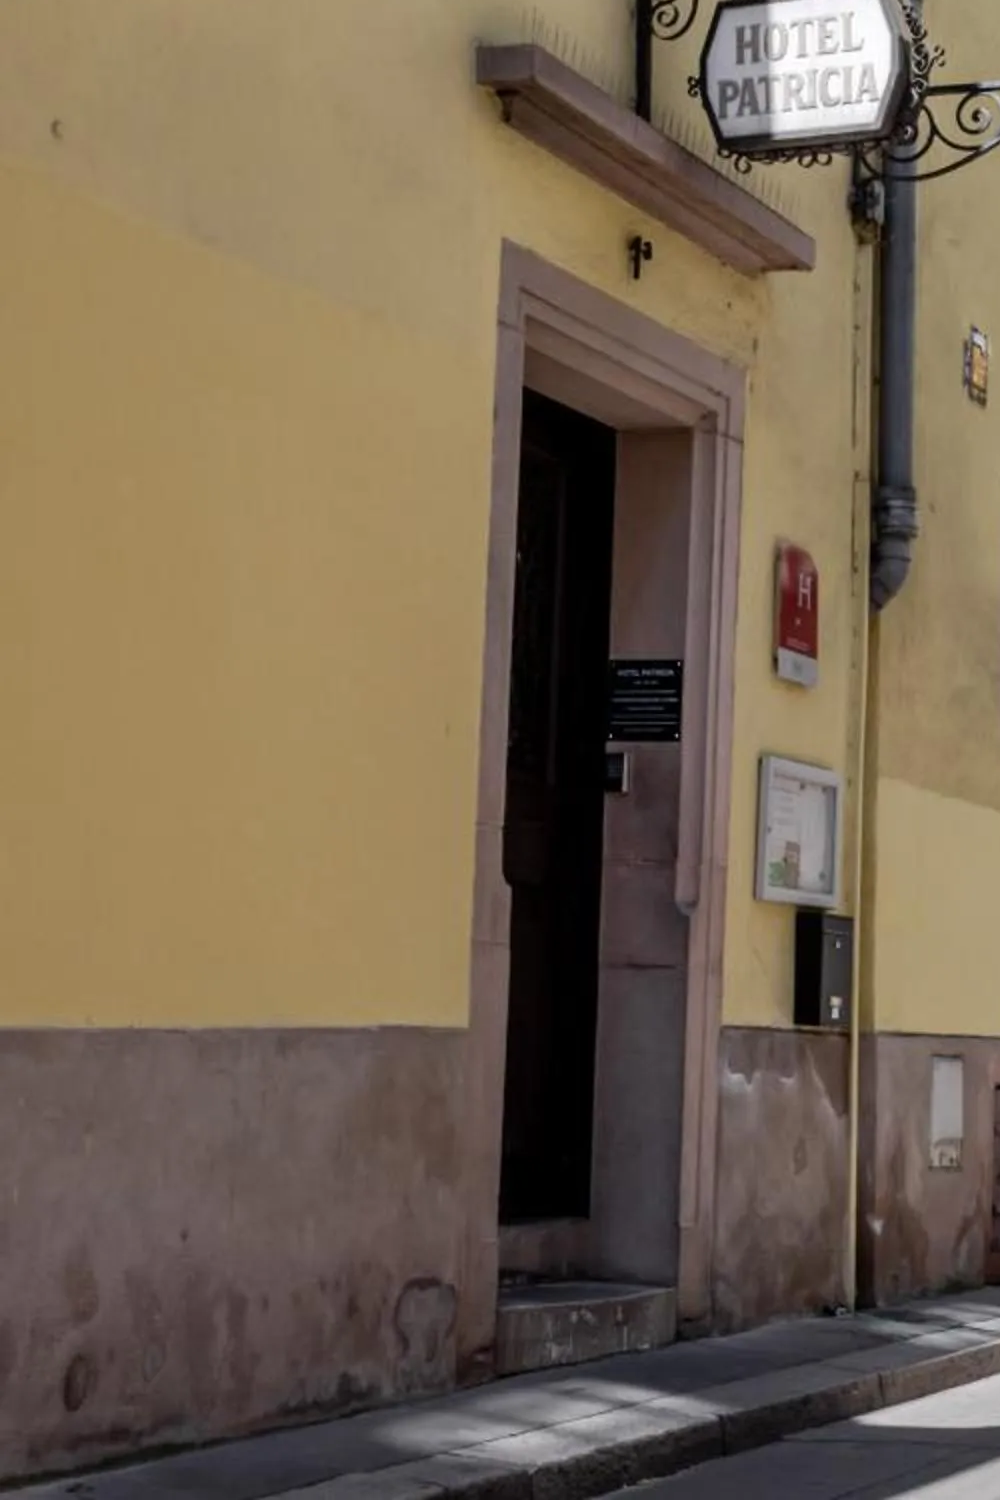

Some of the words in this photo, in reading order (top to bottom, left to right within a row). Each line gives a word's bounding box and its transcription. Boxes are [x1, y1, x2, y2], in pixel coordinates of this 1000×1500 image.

[735, 12, 864, 65] HOTEL
[717, 63, 880, 119] PATRICIA
[797, 571, 813, 611] H
